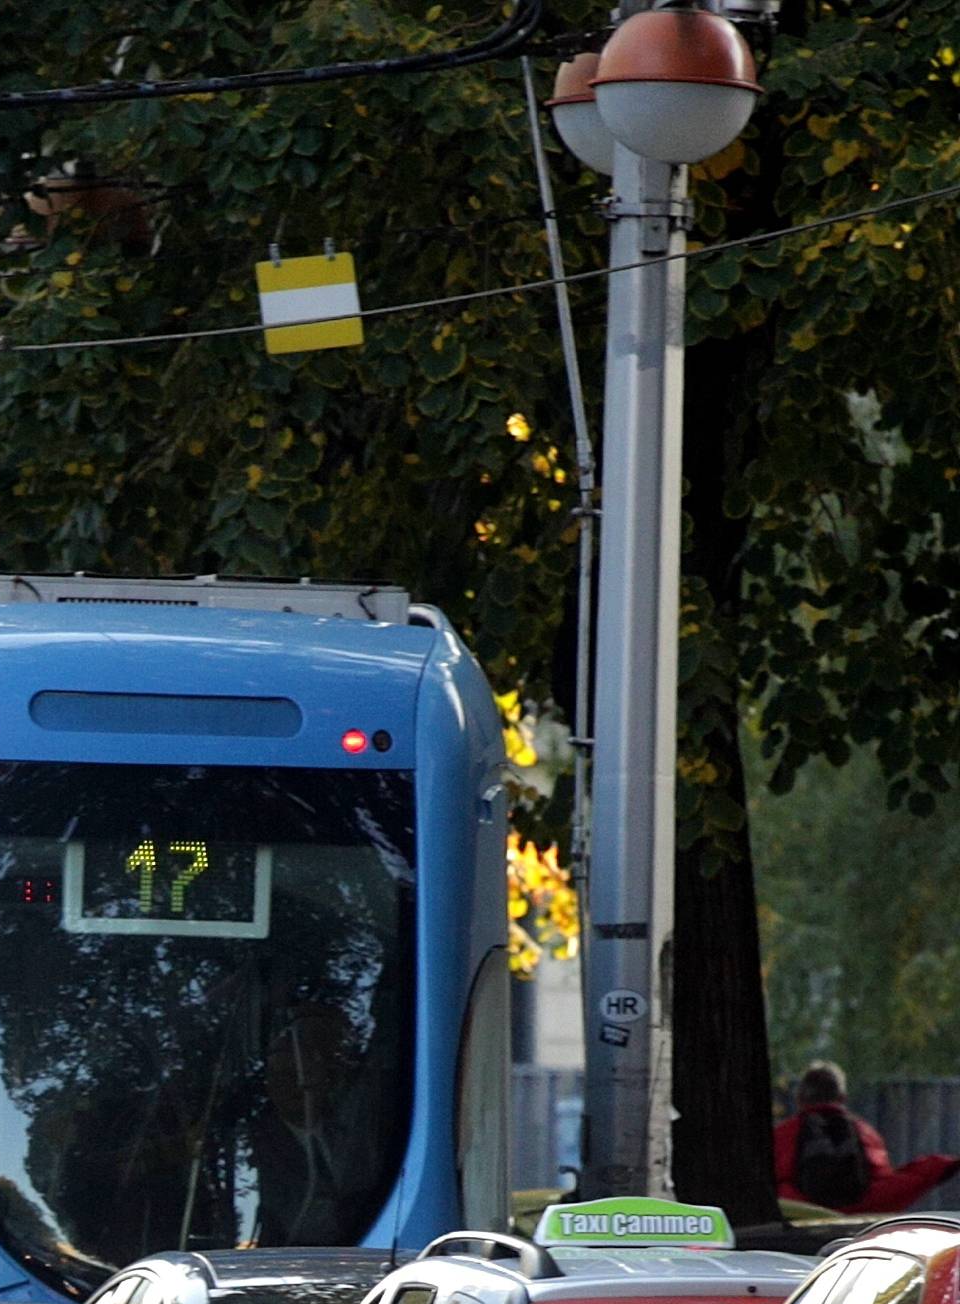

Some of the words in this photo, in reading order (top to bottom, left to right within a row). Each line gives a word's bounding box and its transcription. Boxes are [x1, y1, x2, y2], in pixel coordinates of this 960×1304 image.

[125, 840, 208, 912] 17
[606, 996, 639, 1015] HR
[611, 1212, 714, 1236] Cammeo
